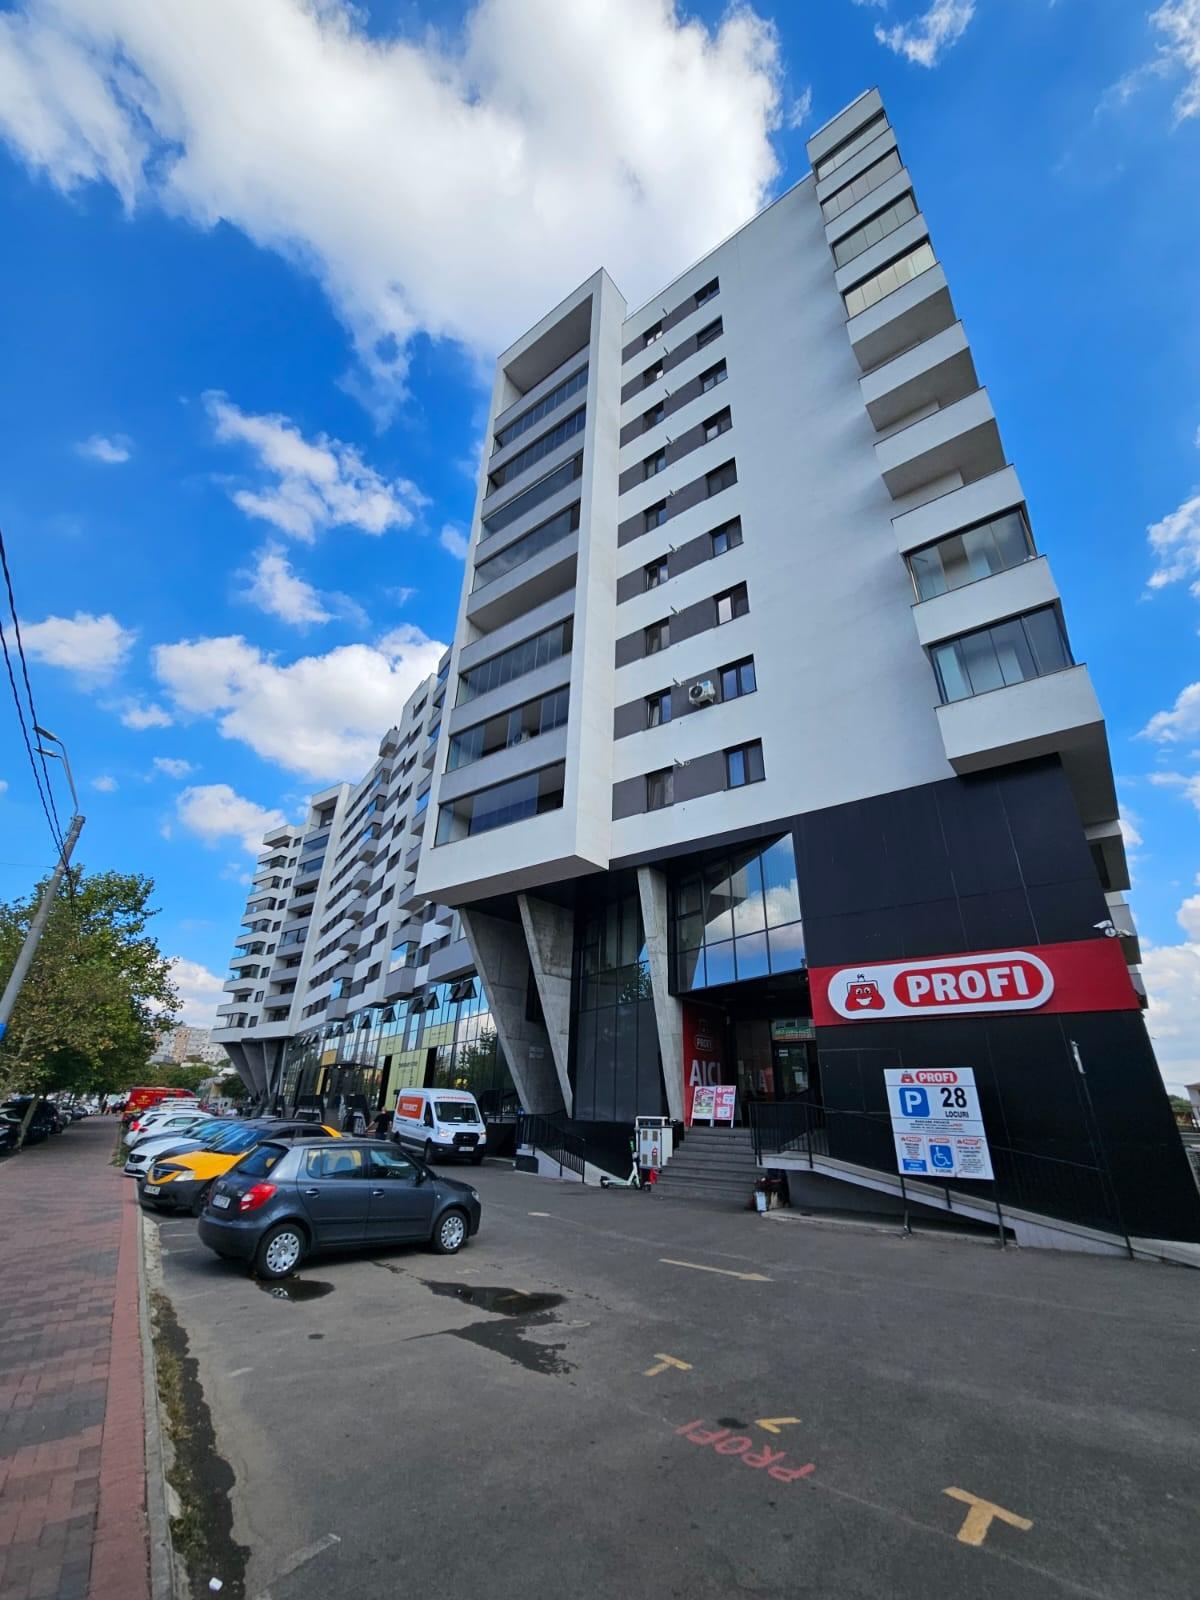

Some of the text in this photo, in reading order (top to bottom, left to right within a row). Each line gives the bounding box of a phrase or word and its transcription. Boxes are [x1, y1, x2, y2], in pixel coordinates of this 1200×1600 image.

[906, 966, 1029, 1003] PROFI
[690, 1059, 721, 1087] AICI
[918, 1072, 955, 1083] PROFI
[904, 1087, 967, 1113] P 28
[945, 1110, 970, 1119] LOCURI
[674, 1419, 815, 1482] PROFI
